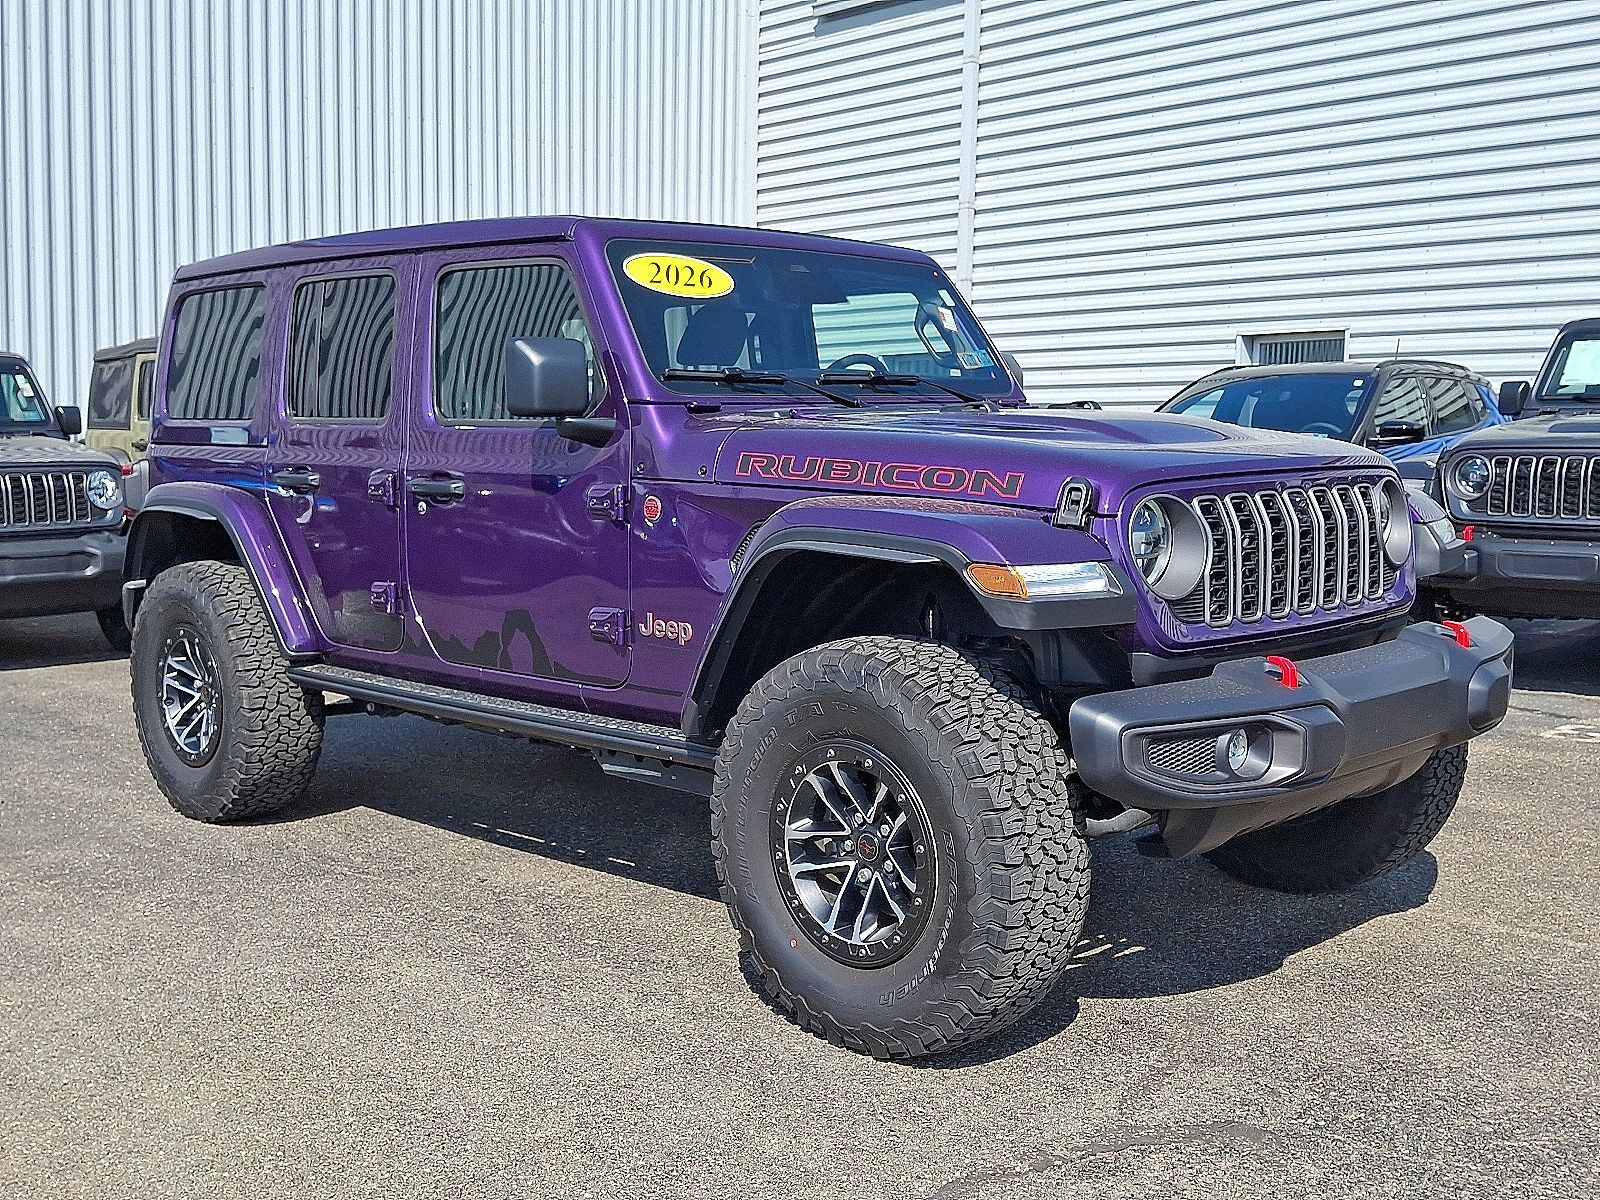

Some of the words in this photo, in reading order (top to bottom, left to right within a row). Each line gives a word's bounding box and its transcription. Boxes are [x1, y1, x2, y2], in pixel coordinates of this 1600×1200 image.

[648, 262, 713, 288] 2026
[736, 452, 1025, 498] RUBICON
[638, 612, 693, 646] Jeep
